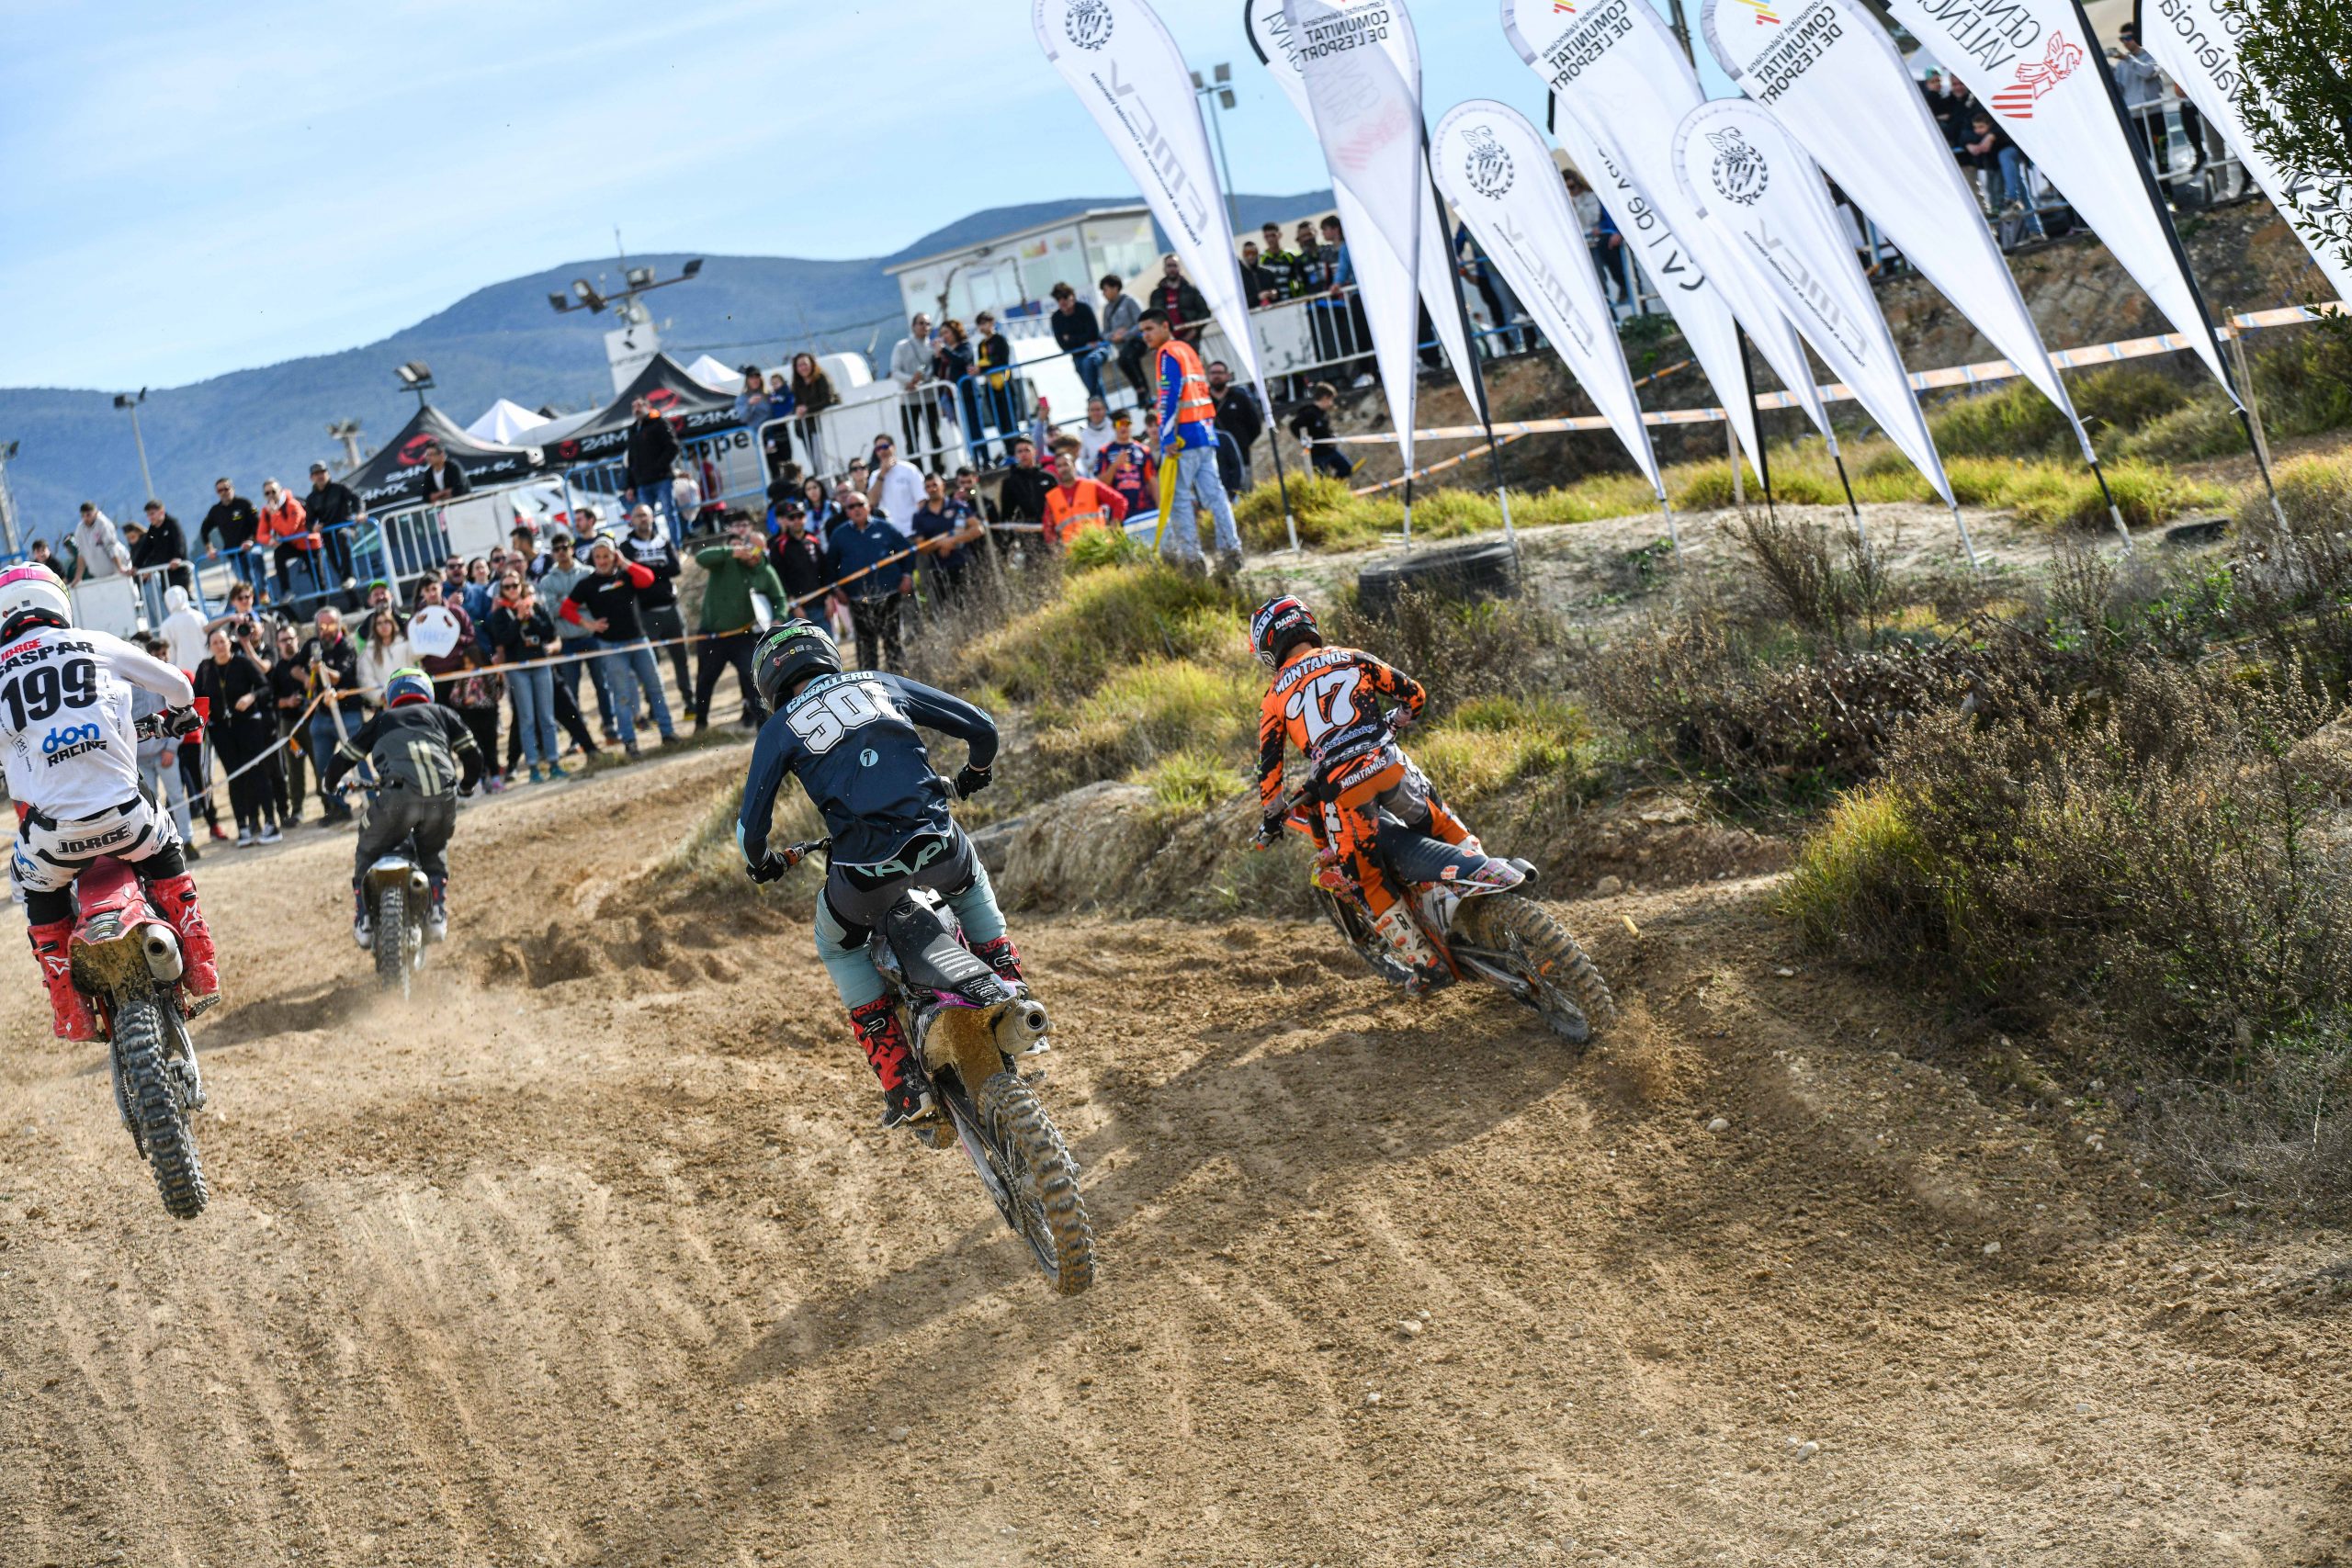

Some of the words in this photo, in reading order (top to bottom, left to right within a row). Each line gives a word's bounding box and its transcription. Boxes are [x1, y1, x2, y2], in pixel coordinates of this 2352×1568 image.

[581, 429, 628, 453] 24M
[1, 658, 97, 733] 199
[786, 671, 875, 715] CABALLERO
[1285, 665, 1362, 747] 17
[46, 739, 107, 768] RACING
[56, 823, 132, 854] JORGE
